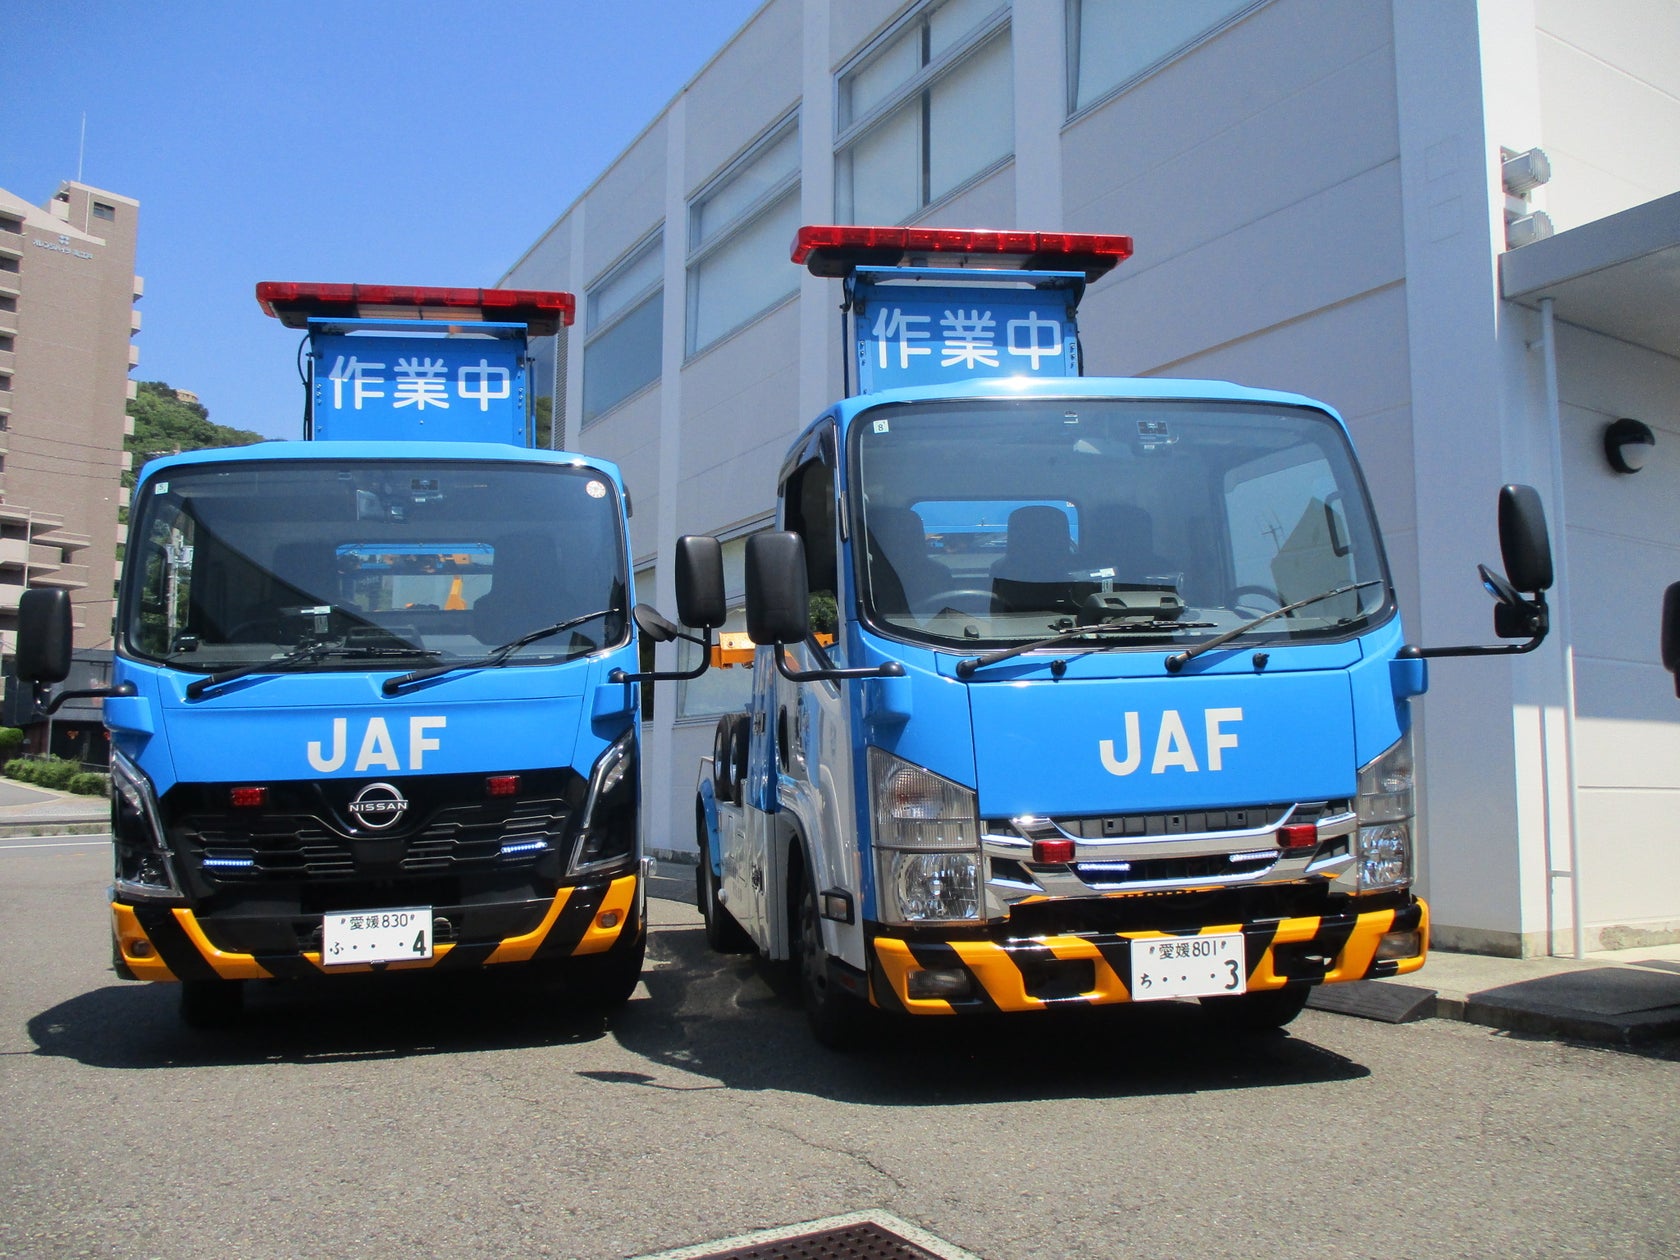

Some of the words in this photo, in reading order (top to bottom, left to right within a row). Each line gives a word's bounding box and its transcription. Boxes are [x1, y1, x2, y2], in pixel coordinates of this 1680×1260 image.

[872, 307, 1062, 371] 作業中
[328, 355, 510, 412] 作業中
[307, 716, 446, 773] JAF
[1099, 707, 1243, 776] JAF
[349, 802, 408, 812] NISSAN
